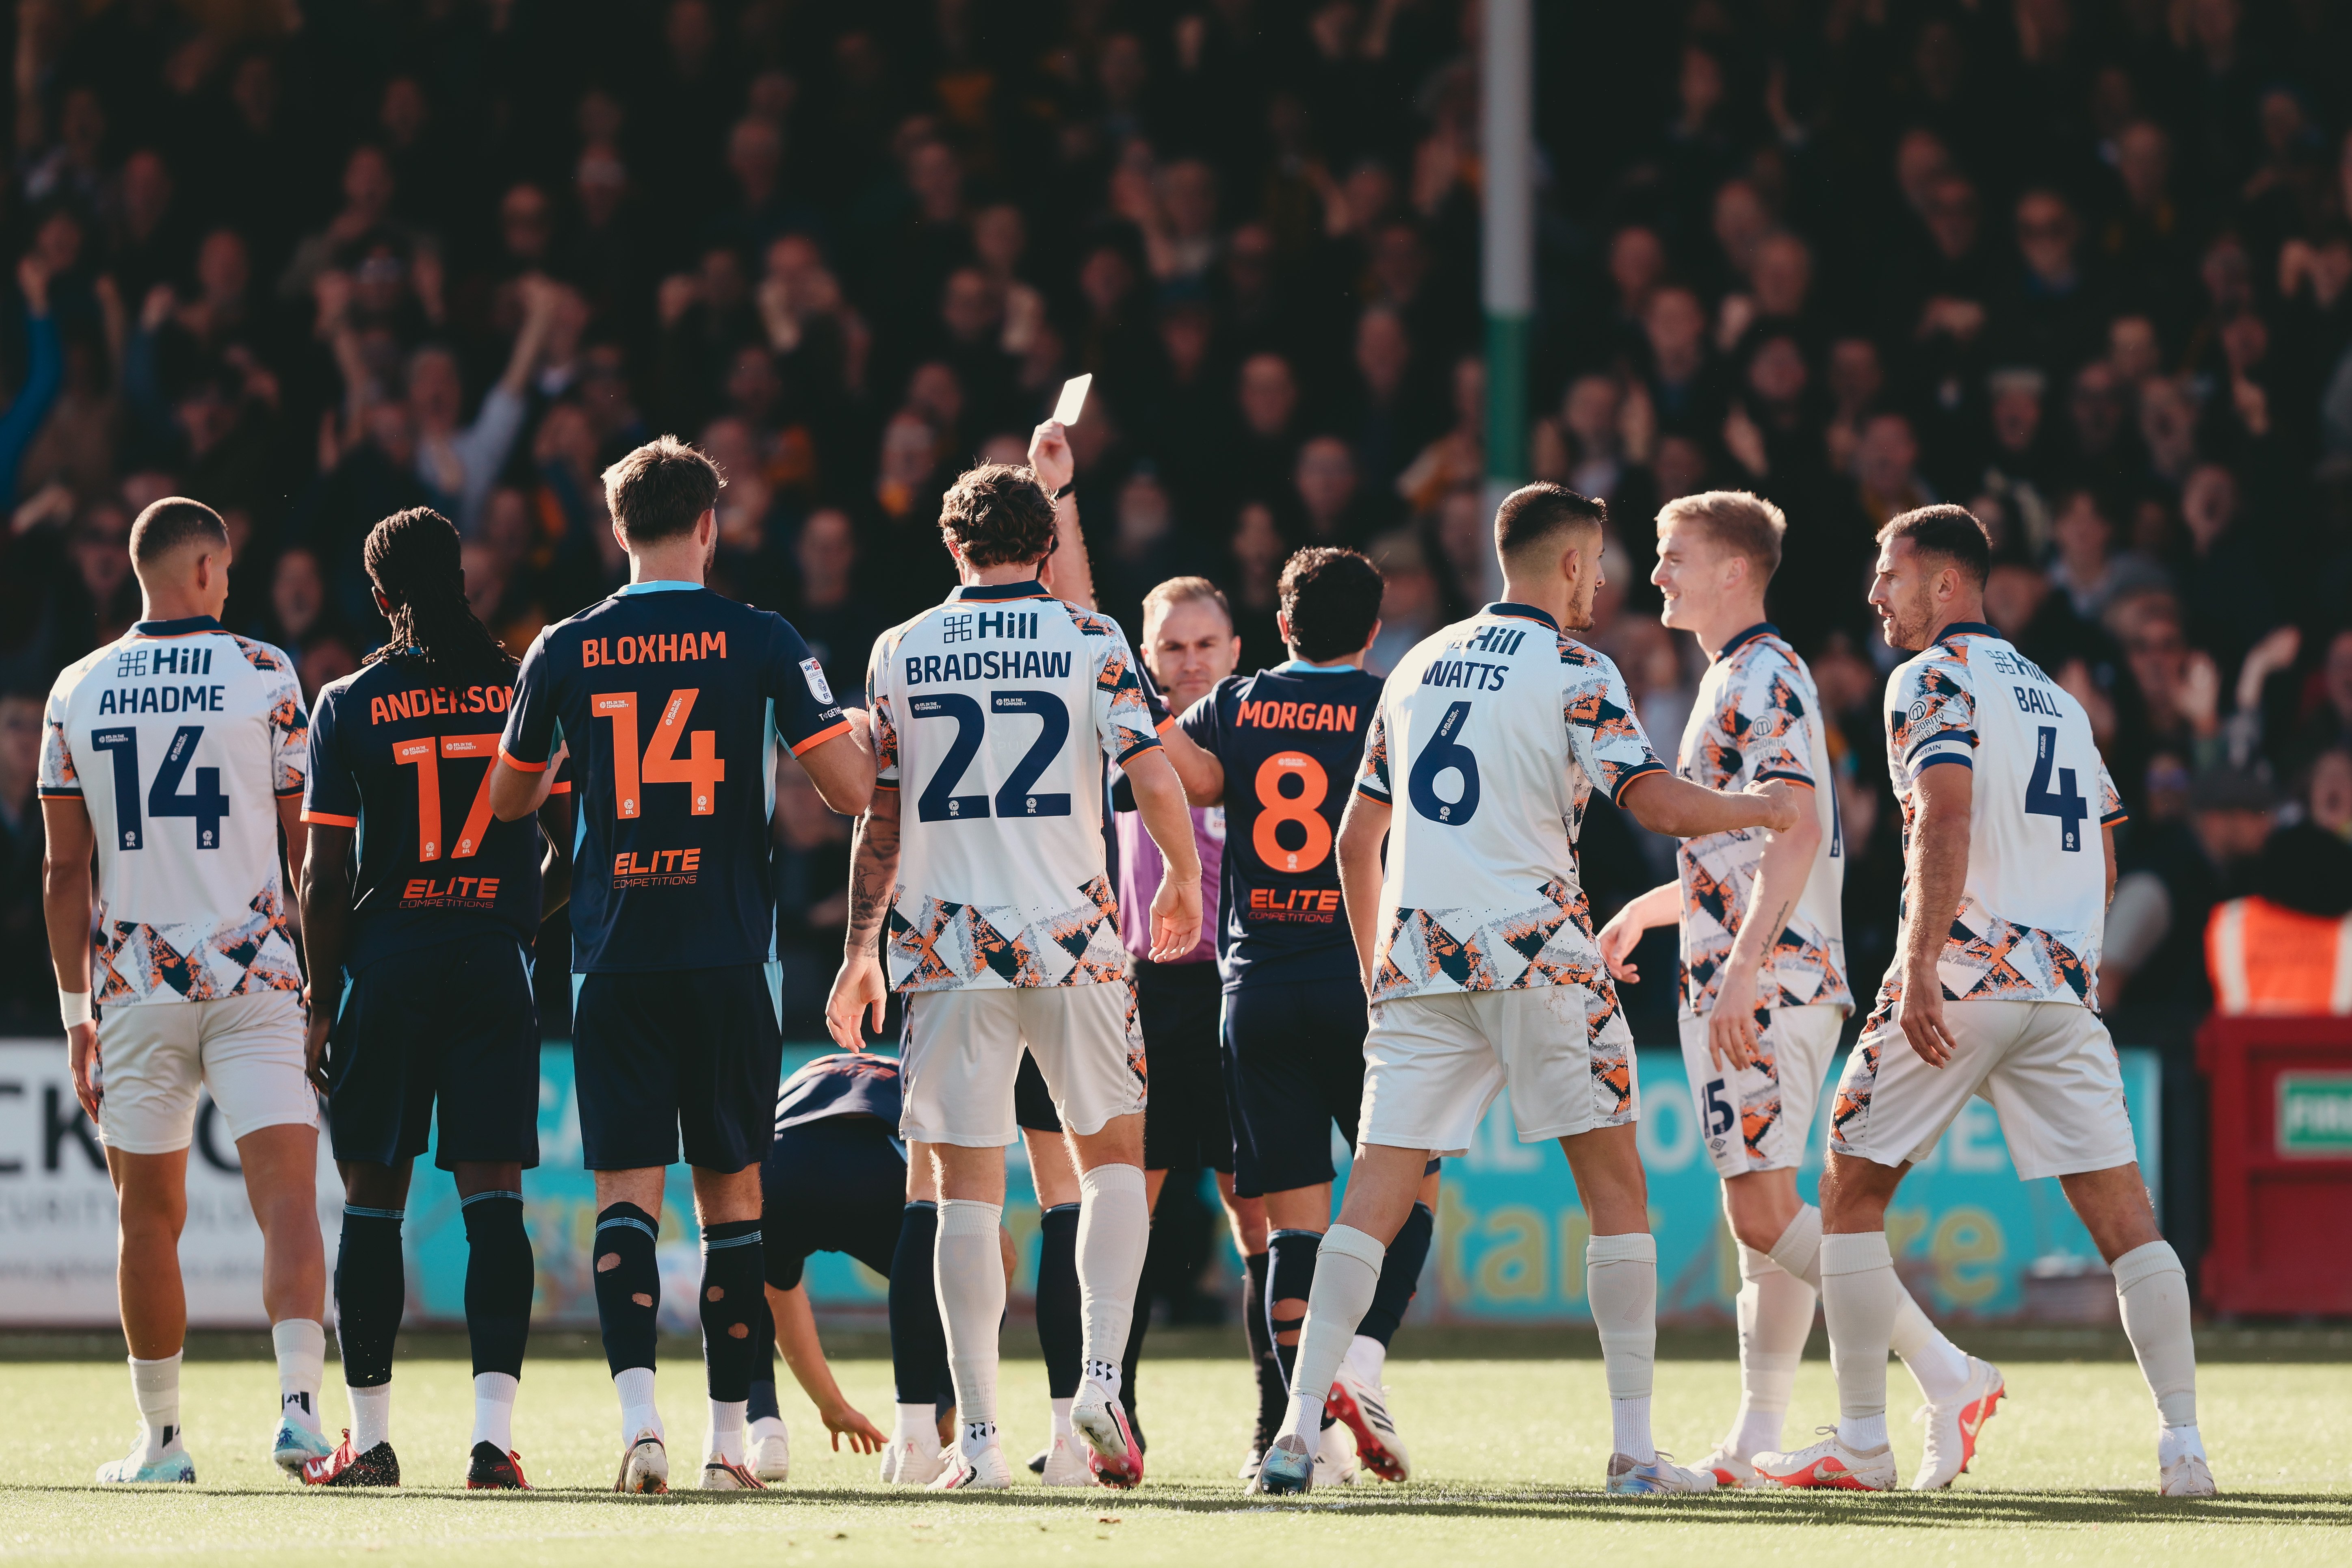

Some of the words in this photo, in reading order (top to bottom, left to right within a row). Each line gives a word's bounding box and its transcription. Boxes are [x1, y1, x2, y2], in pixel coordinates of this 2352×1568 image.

[979, 611, 1038, 639] Hill
[583, 631, 726, 668] BLOXHAM
[1465, 626, 1527, 656] Hill
[152, 648, 212, 675] Hill
[905, 651, 1071, 686] BRADSHAW
[1422, 661, 1510, 691] WATTS
[99, 685, 225, 715] AHADME
[671, 697, 682, 719] COMMUNITY
[2013, 686, 2063, 718] BALL
[1236, 701, 1356, 732] MORGAN
[1446, 709, 1459, 730] COMMUNITY
[1909, 712, 1944, 743] MAJORITY
[1916, 725, 1941, 744] AUDIO
[591, 688, 725, 819] 14
[908, 691, 1071, 823] 22
[1408, 701, 1480, 826] 6
[1916, 744, 1941, 758] APTAIN
[91, 726, 229, 850] 14
[392, 733, 503, 862] 17
[2025, 726, 2088, 852] 4
[1253, 751, 1332, 873] 8
[614, 848, 701, 875] ELITE
[403, 877, 500, 899] ELITE
[614, 875, 697, 889] COMPETITIONS
[399, 899, 494, 908] COMPETITIONS
[1251, 889, 1341, 911] ELITE
[1248, 912, 1334, 923] COMPETITIONS
